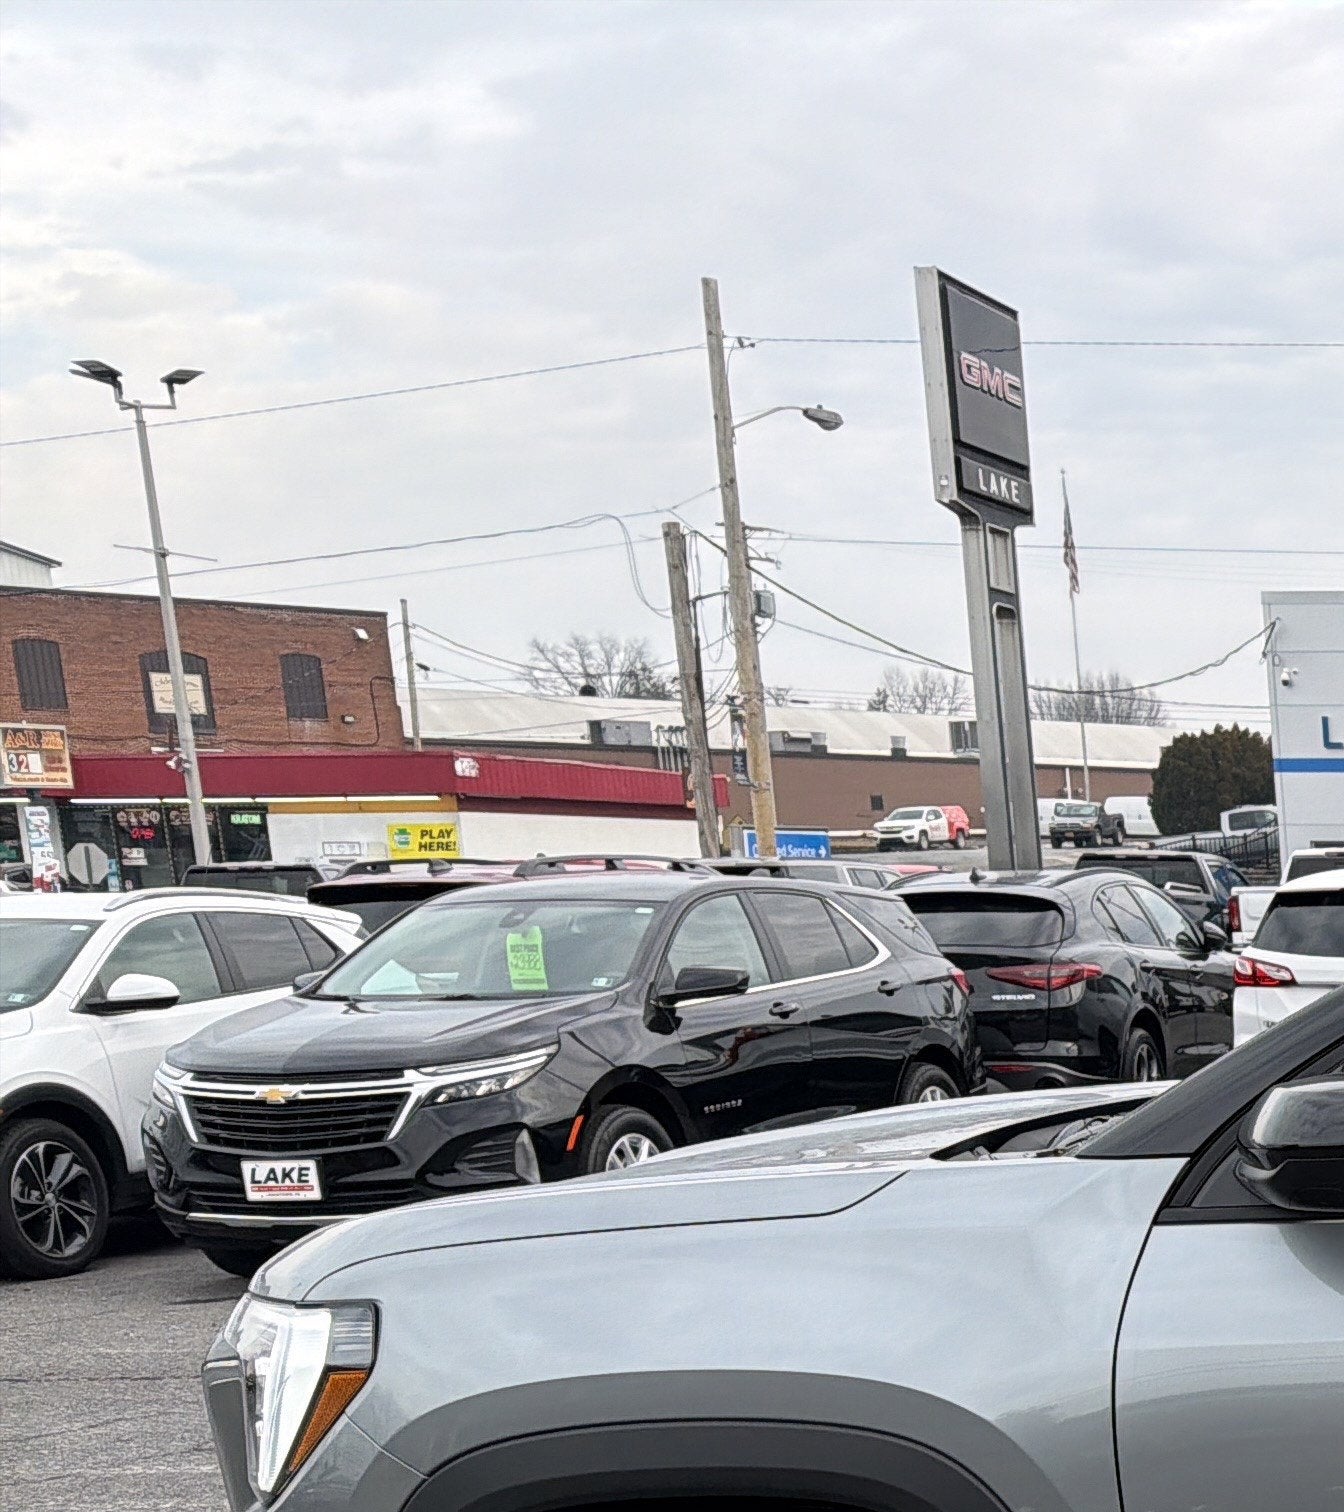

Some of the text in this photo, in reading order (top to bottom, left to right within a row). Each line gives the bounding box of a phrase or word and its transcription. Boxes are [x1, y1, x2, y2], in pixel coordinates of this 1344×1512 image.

[961, 351, 1022, 409] GMC
[978, 467, 1020, 504] LAKE
[419, 828, 453, 840] PLAY
[417, 841, 457, 852] HERE!
[787, 843, 816, 858] Service
[250, 1165, 311, 1185] LAKE
